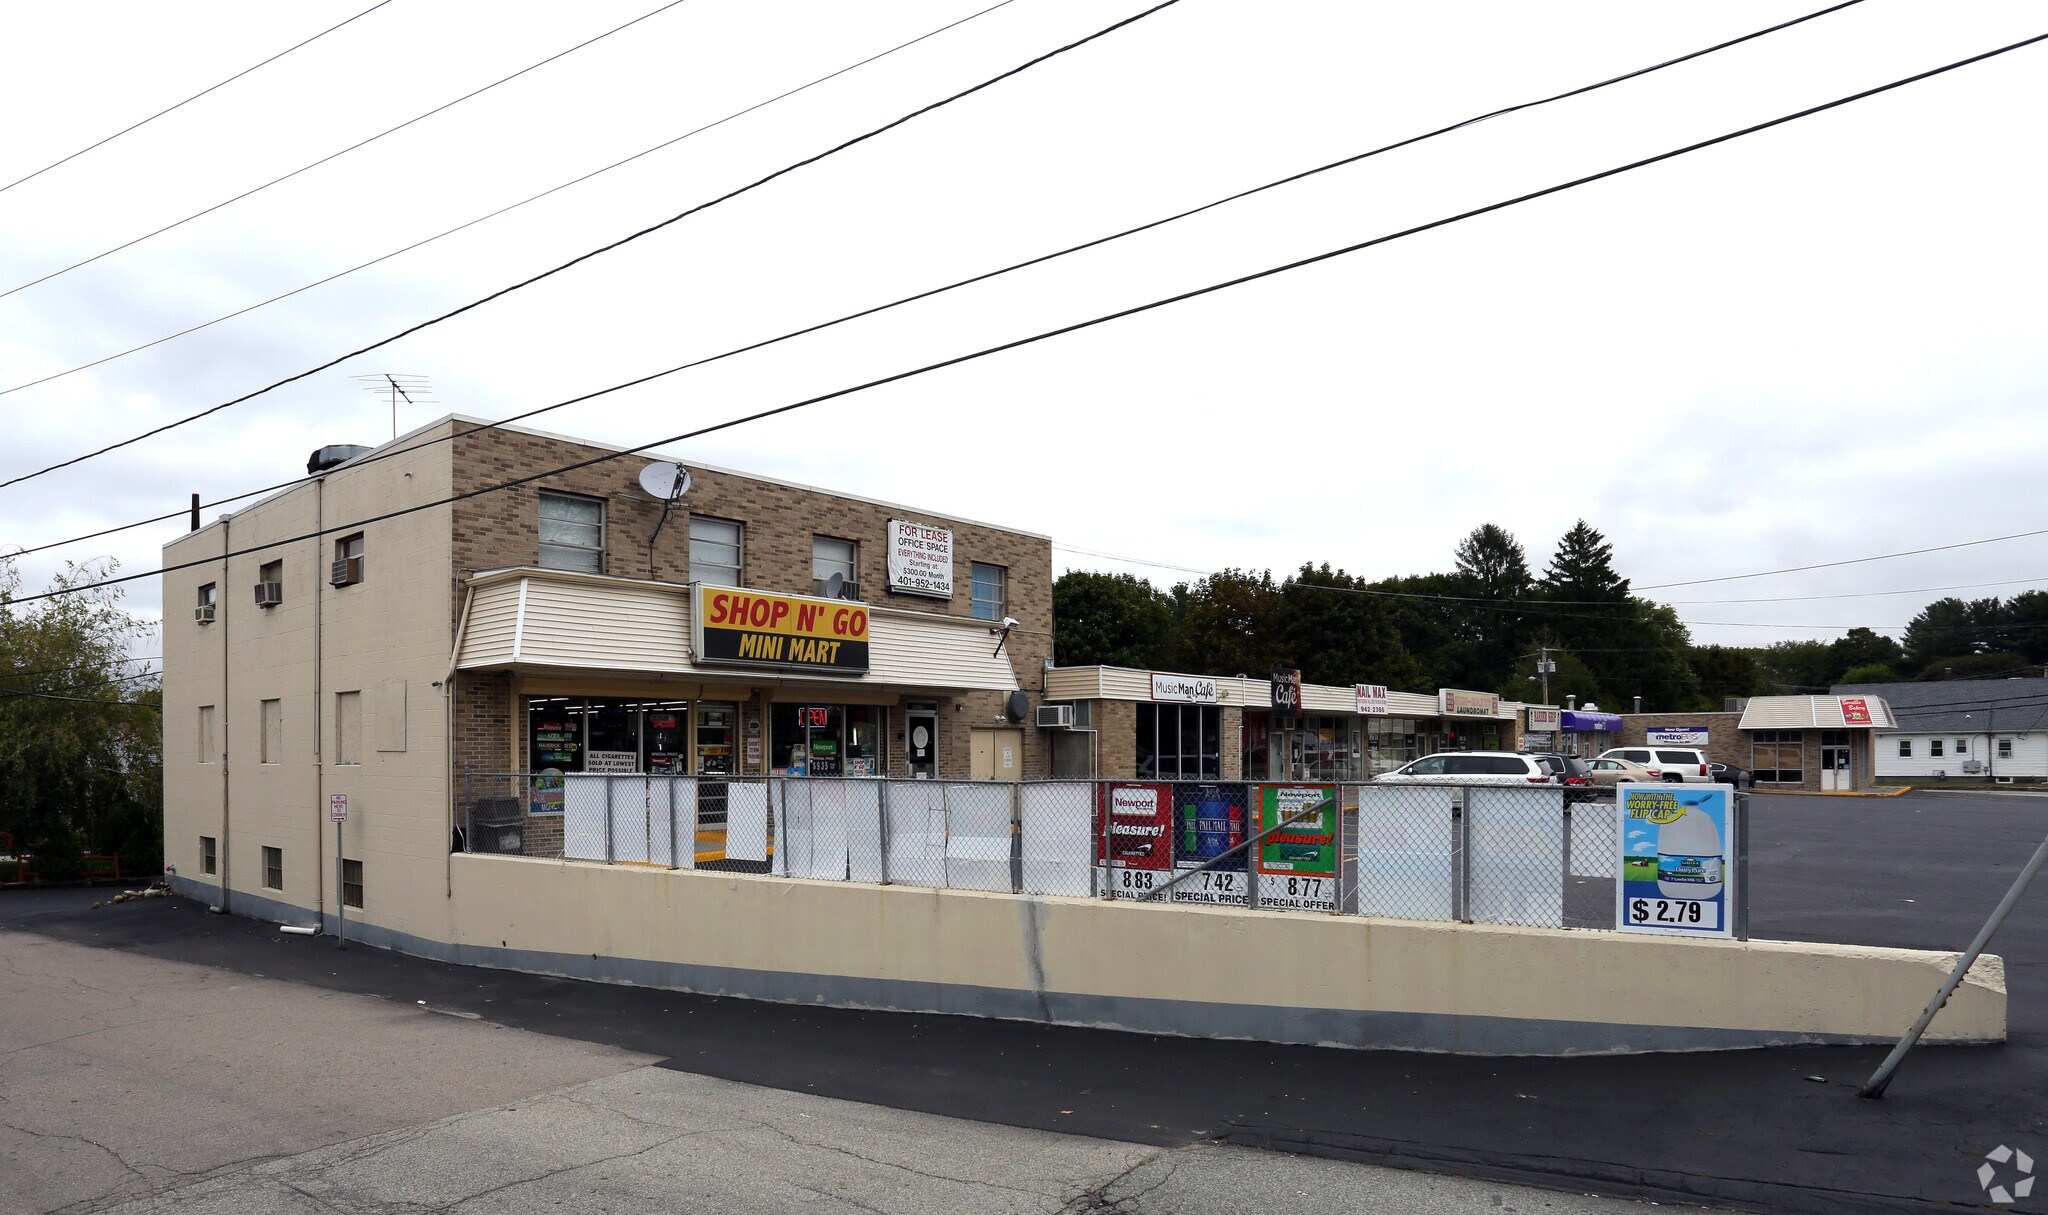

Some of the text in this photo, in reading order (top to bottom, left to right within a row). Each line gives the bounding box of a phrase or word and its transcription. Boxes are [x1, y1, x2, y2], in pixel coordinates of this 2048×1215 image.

[900, 525, 948, 543] FOR LEASE
[898, 537, 948, 553] OFFICE SPACE
[898, 548, 948, 563] EVERYTHING INCLUDED
[909, 559, 930, 569] Starting
[898, 576, 950, 591] 401-952-1434
[710, 594, 867, 637] SHOP N' GO
[738, 634, 841, 664] MINI MART
[1156, 680, 1215, 700] Music Man Café
[1276, 684, 1298, 708] Café
[1357, 686, 1386, 699] NAIL MAX
[1457, 706, 1489, 716] LAUNDROMAT
[1115, 798, 1154, 808] Newport
[1626, 800, 1678, 810] WORRY-FREE
[1631, 809, 1650, 818] FLIP
[1266, 830, 1334, 846] pleasure!
[1123, 870, 1152, 890] 8.83
[1202, 872, 1234, 892] 7.42
[1288, 878, 1322, 897] 8.77
[1100, 889, 1136, 899] SECIAL
[1175, 892, 1216, 902] SPECIAL
[1260, 897, 1335, 910] SPECIAL OFFER
[1632, 898, 1700, 923] $ 2.79
